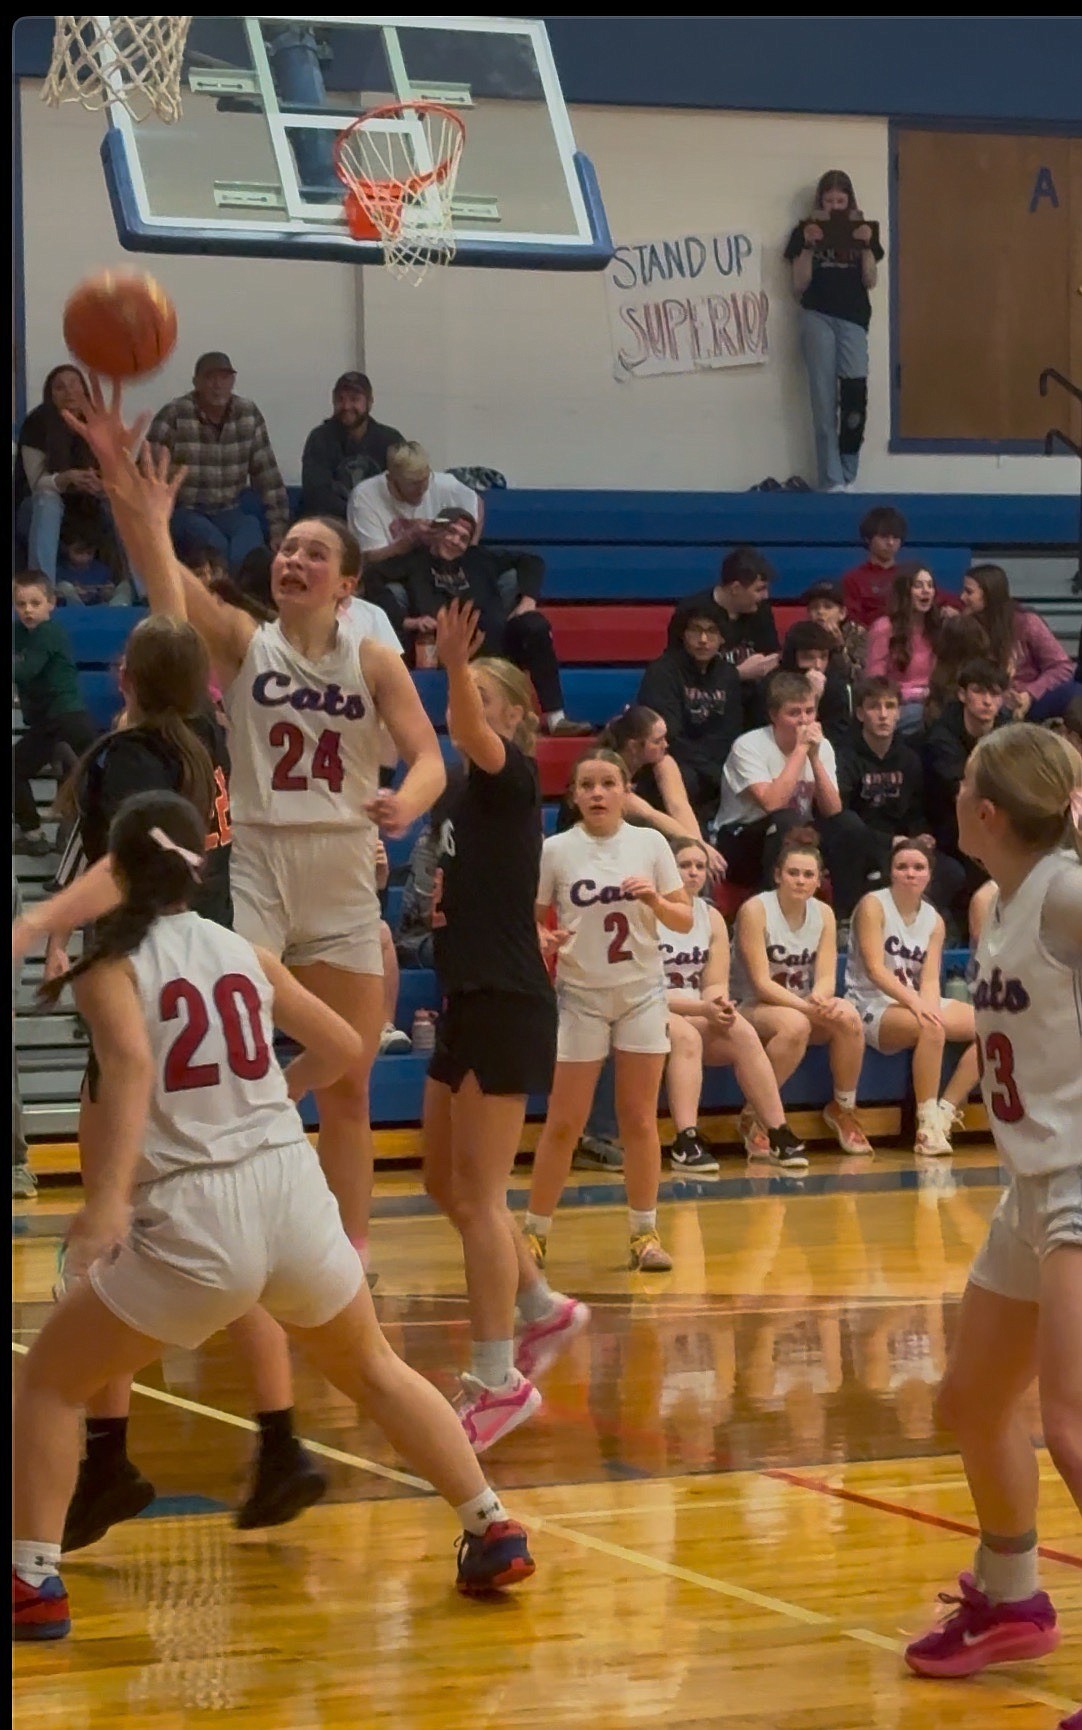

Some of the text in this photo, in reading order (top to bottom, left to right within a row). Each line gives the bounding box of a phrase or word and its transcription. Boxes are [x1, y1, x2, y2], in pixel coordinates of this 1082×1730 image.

[1029, 166, 1059, 213] A
[612, 234, 752, 289] STAND UP
[252, 670, 365, 721] Cats
[269, 721, 344, 793] 24
[603, 911, 633, 964] 2
[974, 960, 1031, 1014] ats
[159, 972, 270, 1093] 20
[975, 1032, 1024, 1122] 3
